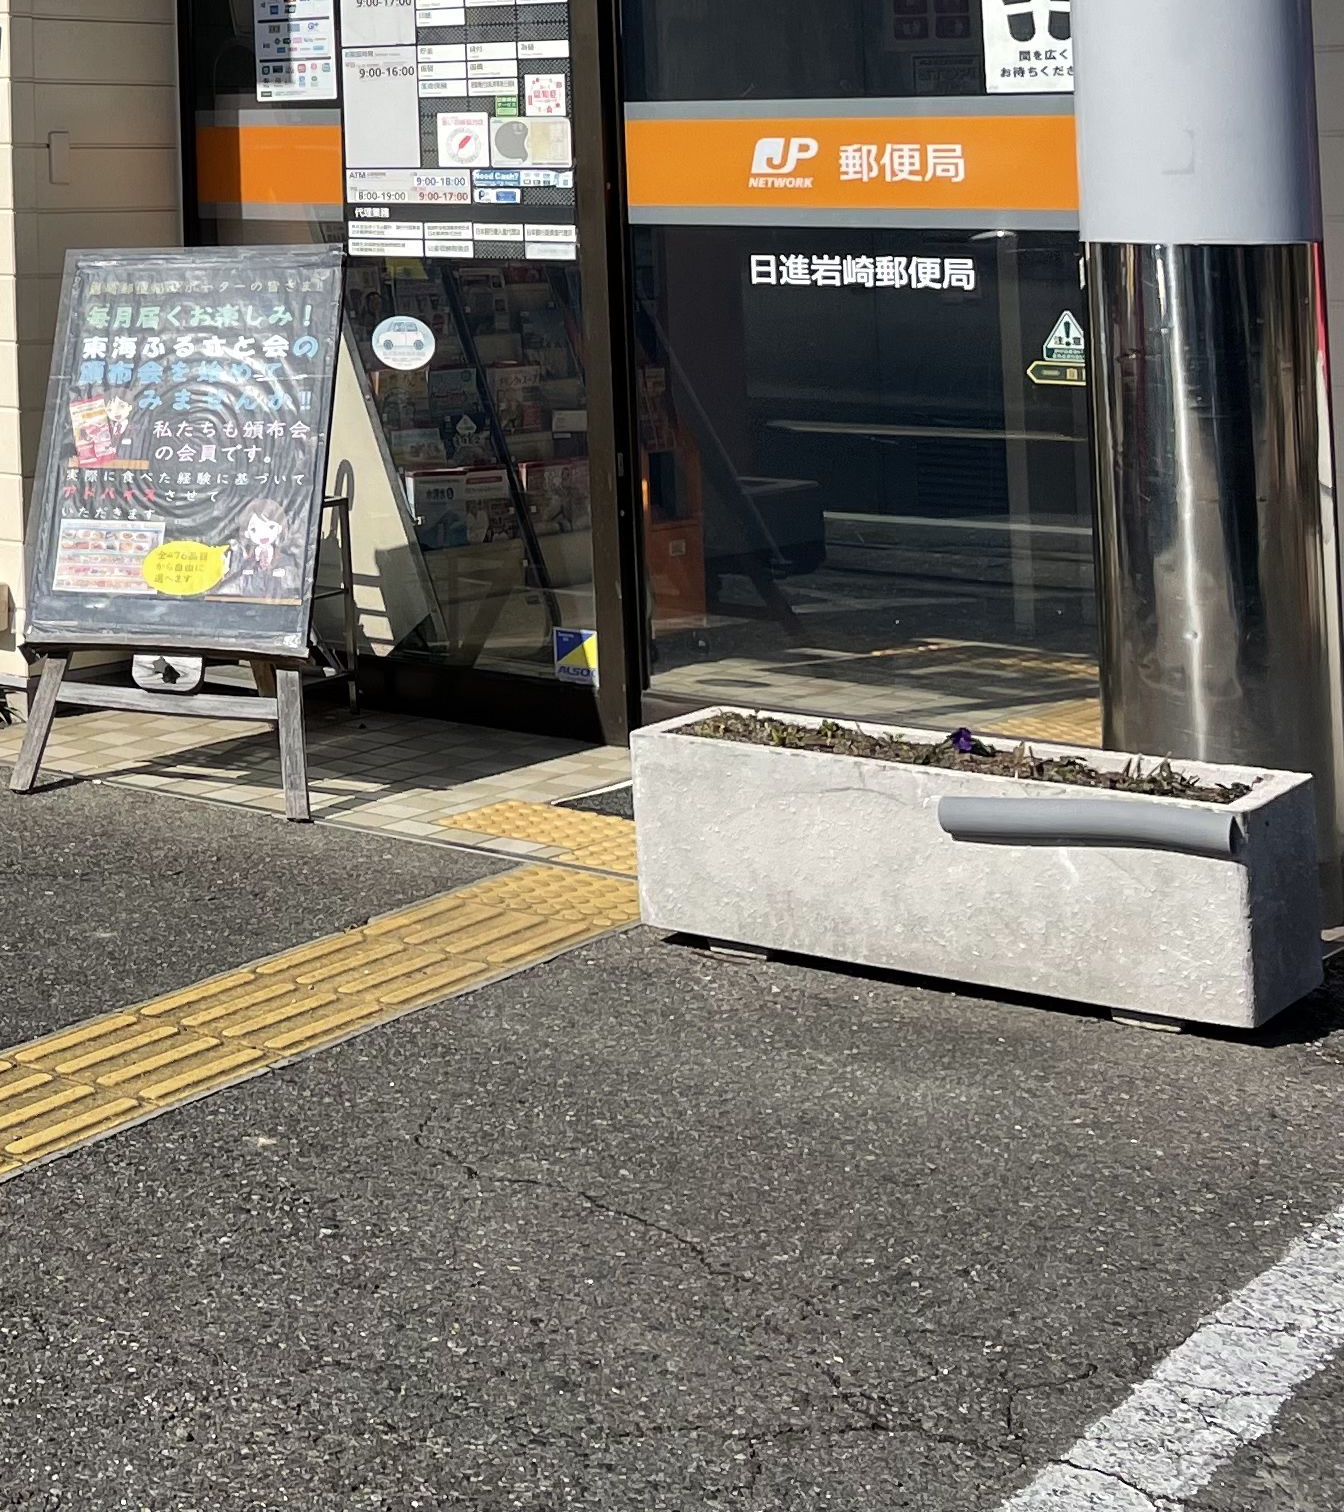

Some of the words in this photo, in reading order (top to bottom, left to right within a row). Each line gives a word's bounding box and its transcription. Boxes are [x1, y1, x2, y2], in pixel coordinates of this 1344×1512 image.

[1018, 49, 1069, 62] 間を広く
[359, 65, 415, 78] 9:00-16:00
[751, 136, 818, 175] JP
[839, 142, 966, 183] 郵便局
[416, 177, 466, 186] 9:00-18:00
[748, 176, 814, 189] NETWORK
[418, 191, 469, 201] 9:00-17:00
[750, 253, 976, 291] 日進岩崎郵便局
[82, 335, 320, 360] 東海ふるさと会の
[153, 420, 311, 439] 私たちも頒布会
[155, 444, 272, 464] の会員です。
[66, 469, 306, 487] 実際に食べた経験に基づいて
